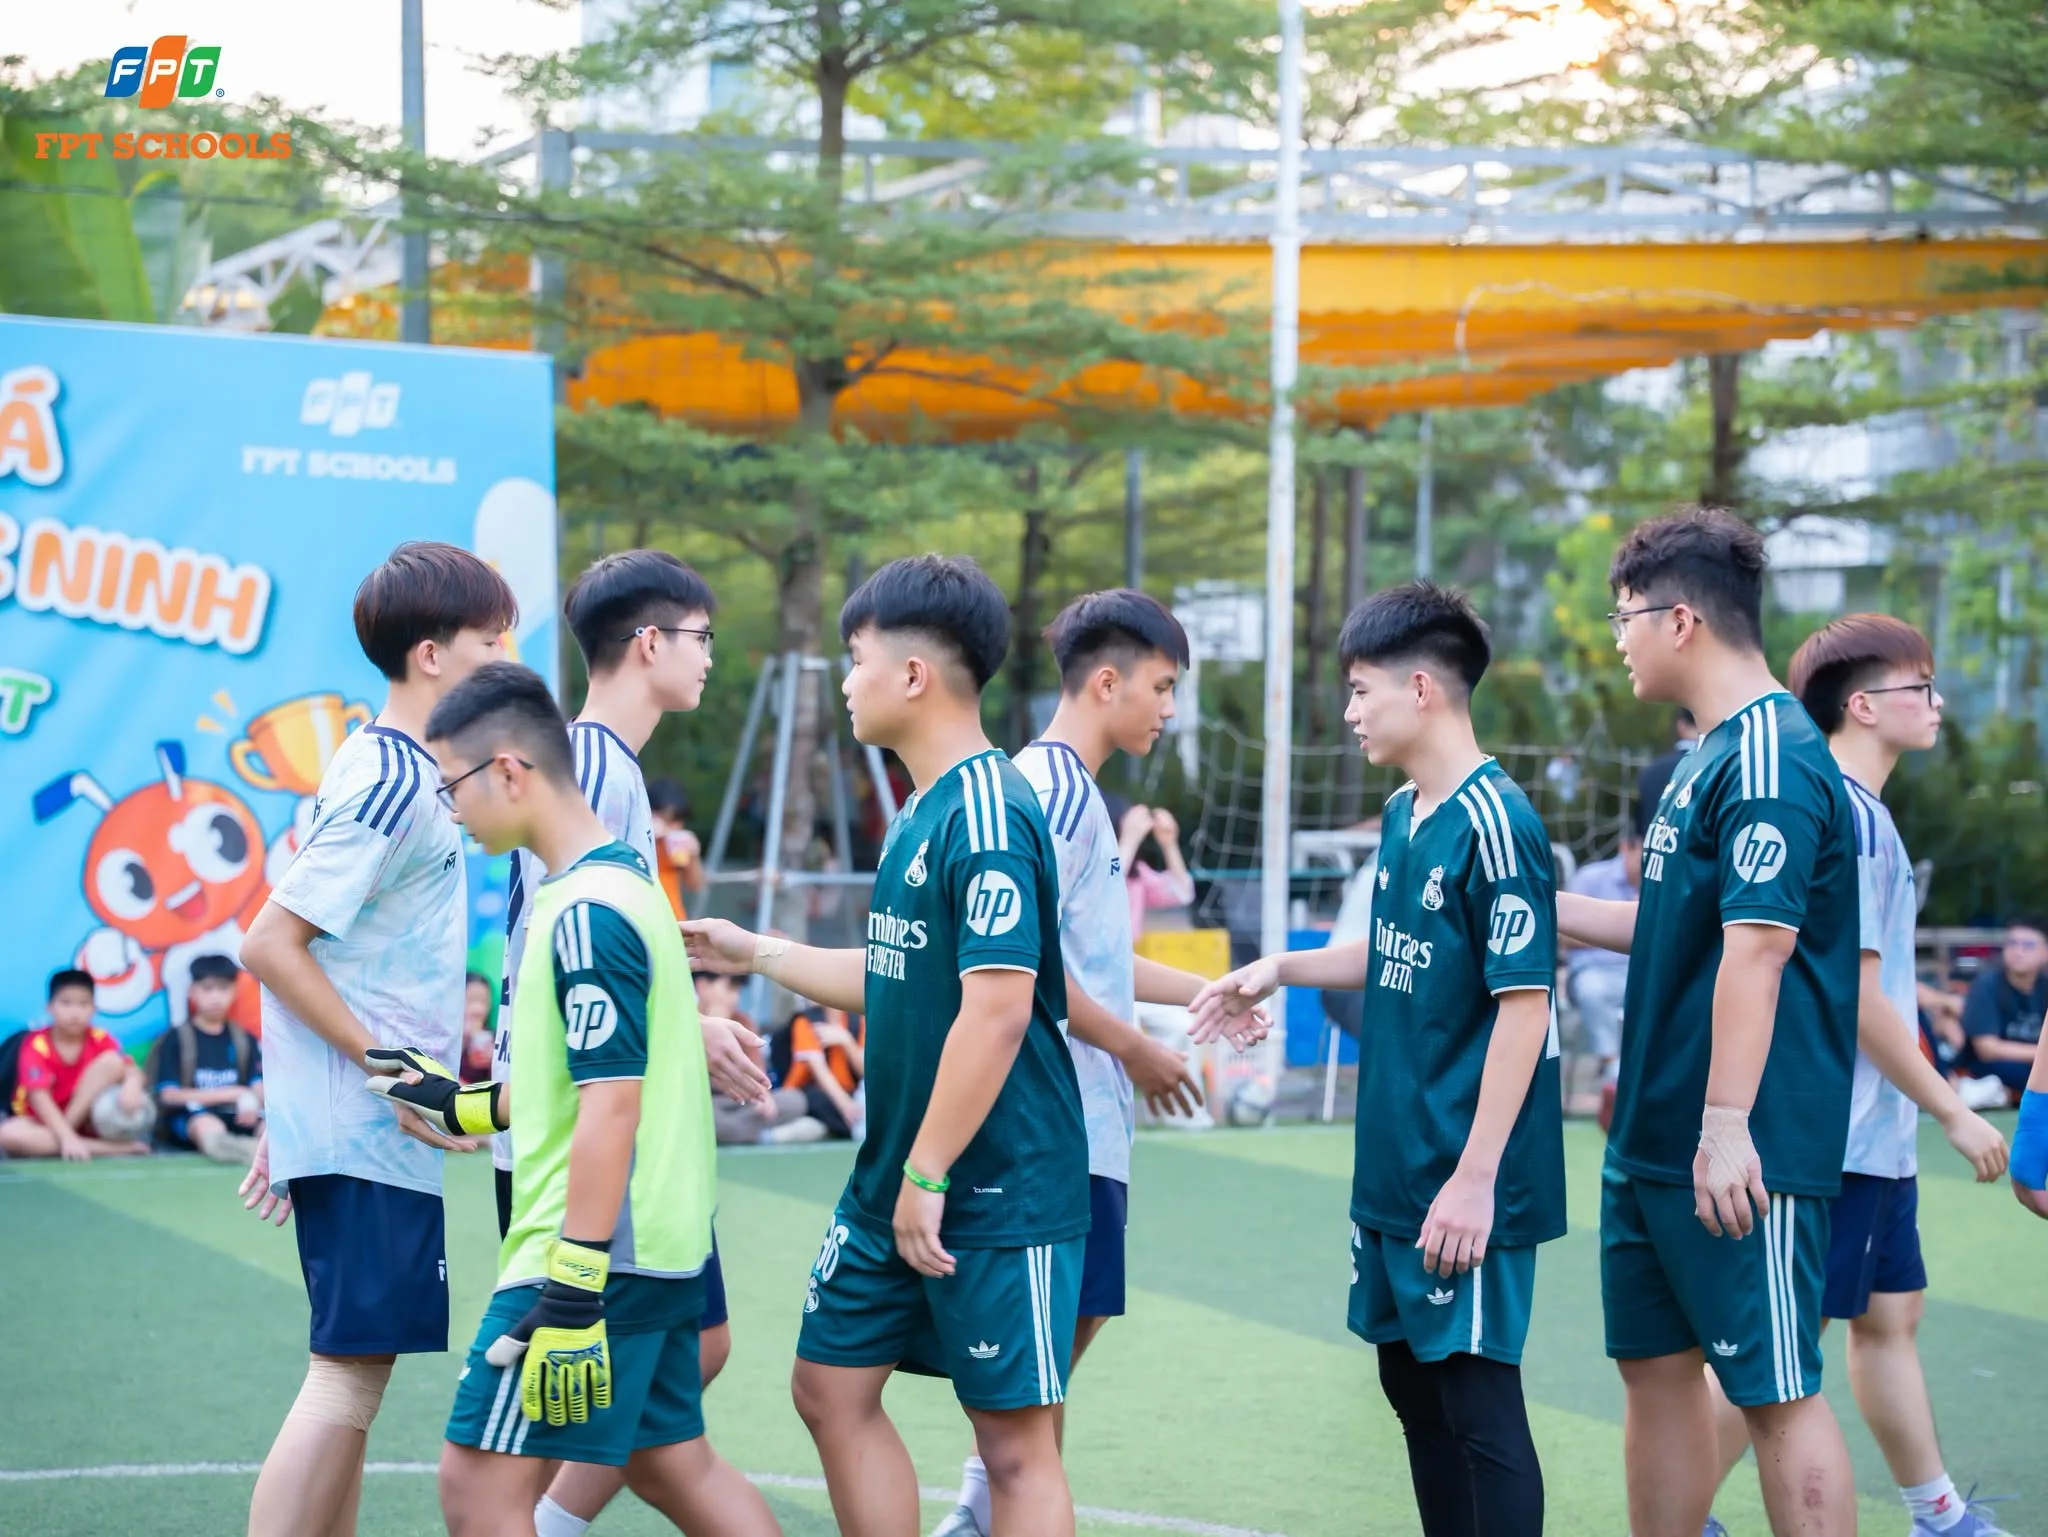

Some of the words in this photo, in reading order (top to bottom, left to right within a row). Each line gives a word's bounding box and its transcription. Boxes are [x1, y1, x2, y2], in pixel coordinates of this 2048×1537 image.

[26, 527, 262, 643] NINH
[1738, 822, 1782, 884] hp
[969, 869, 1015, 936] hp
[1490, 894, 1529, 956] hp
